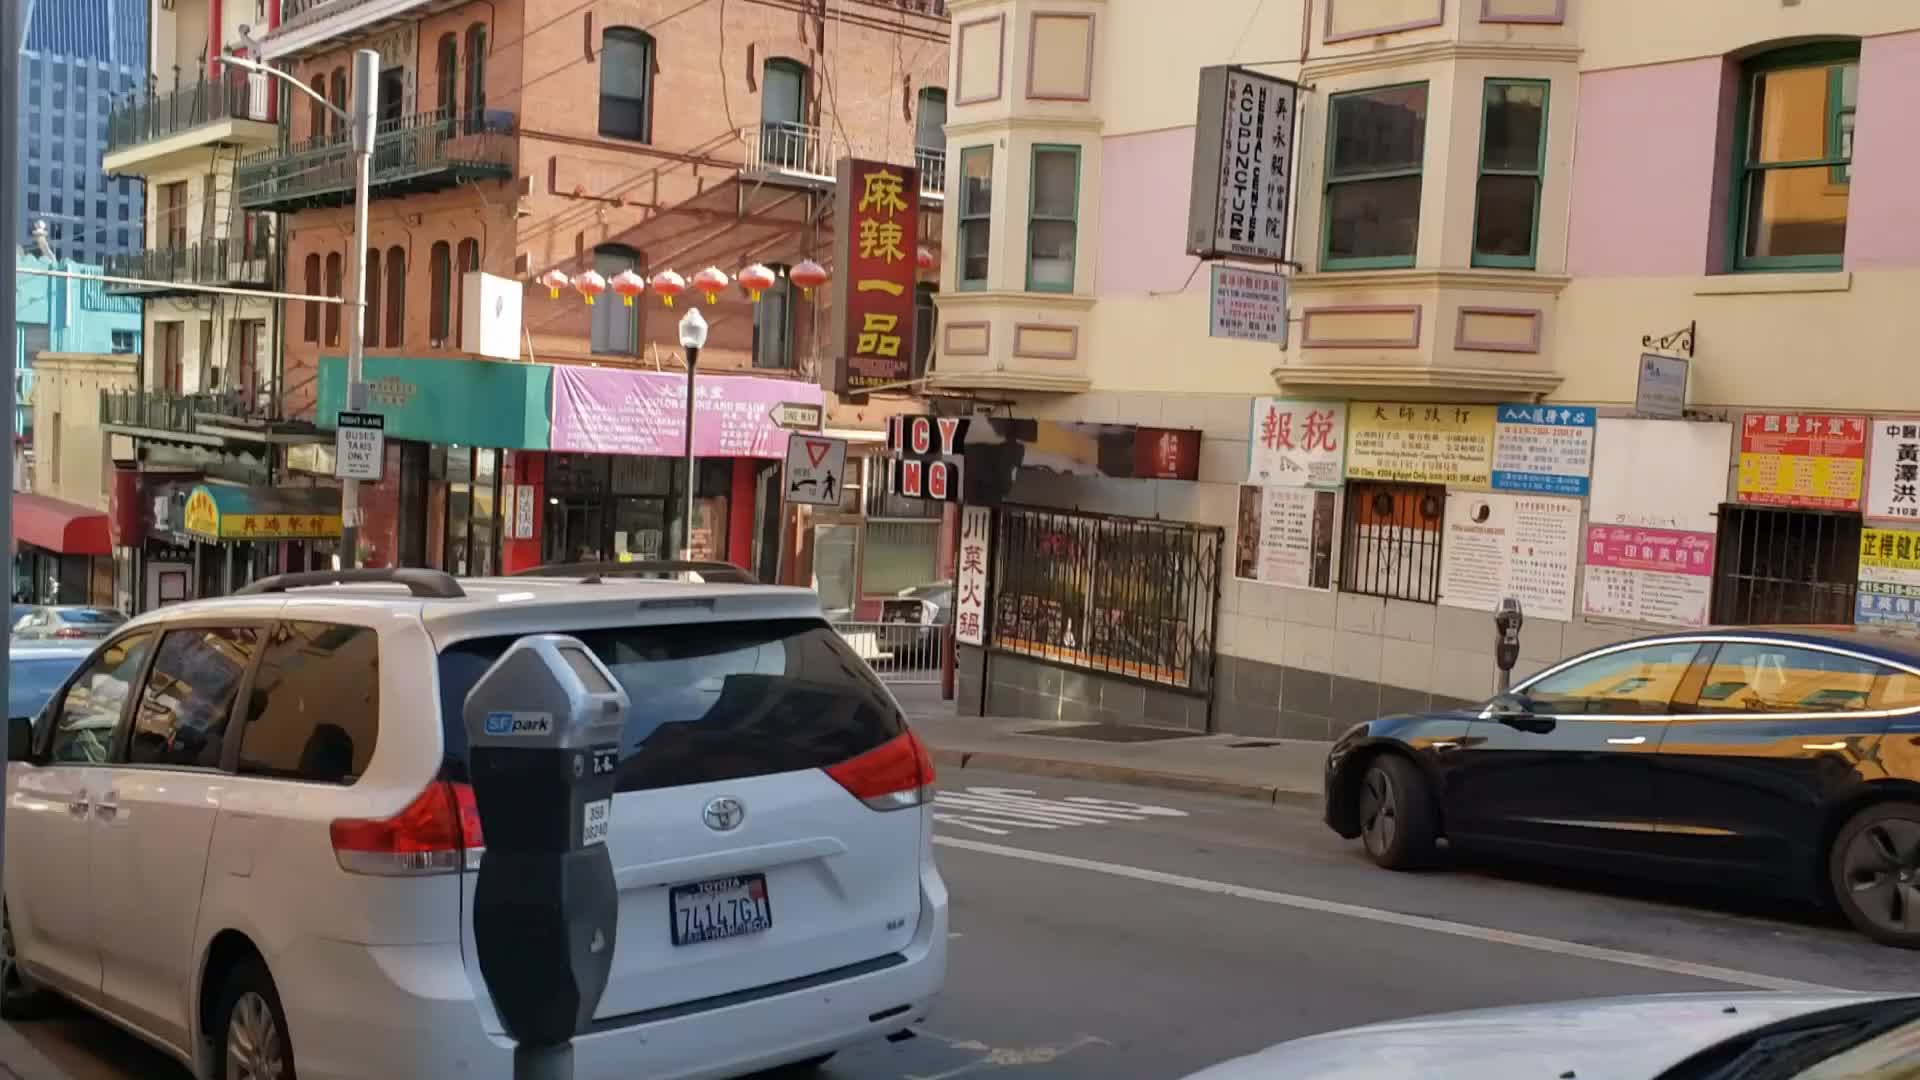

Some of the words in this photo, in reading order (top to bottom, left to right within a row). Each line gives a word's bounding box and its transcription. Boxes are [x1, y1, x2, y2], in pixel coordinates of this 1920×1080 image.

[1230, 83, 1253, 241] ACUPUNCTURE
[1254, 88, 1266, 163] HERBAL
[1248, 167, 1260, 242] CENTER
[856, 169, 908, 356] 麻辣一品
[345, 432, 376, 441] BUSES
[348, 451, 370, 460] ONLY
[959, 512, 986, 640] 川菜火鍋
[701, 878, 739, 893] TOYOTA
